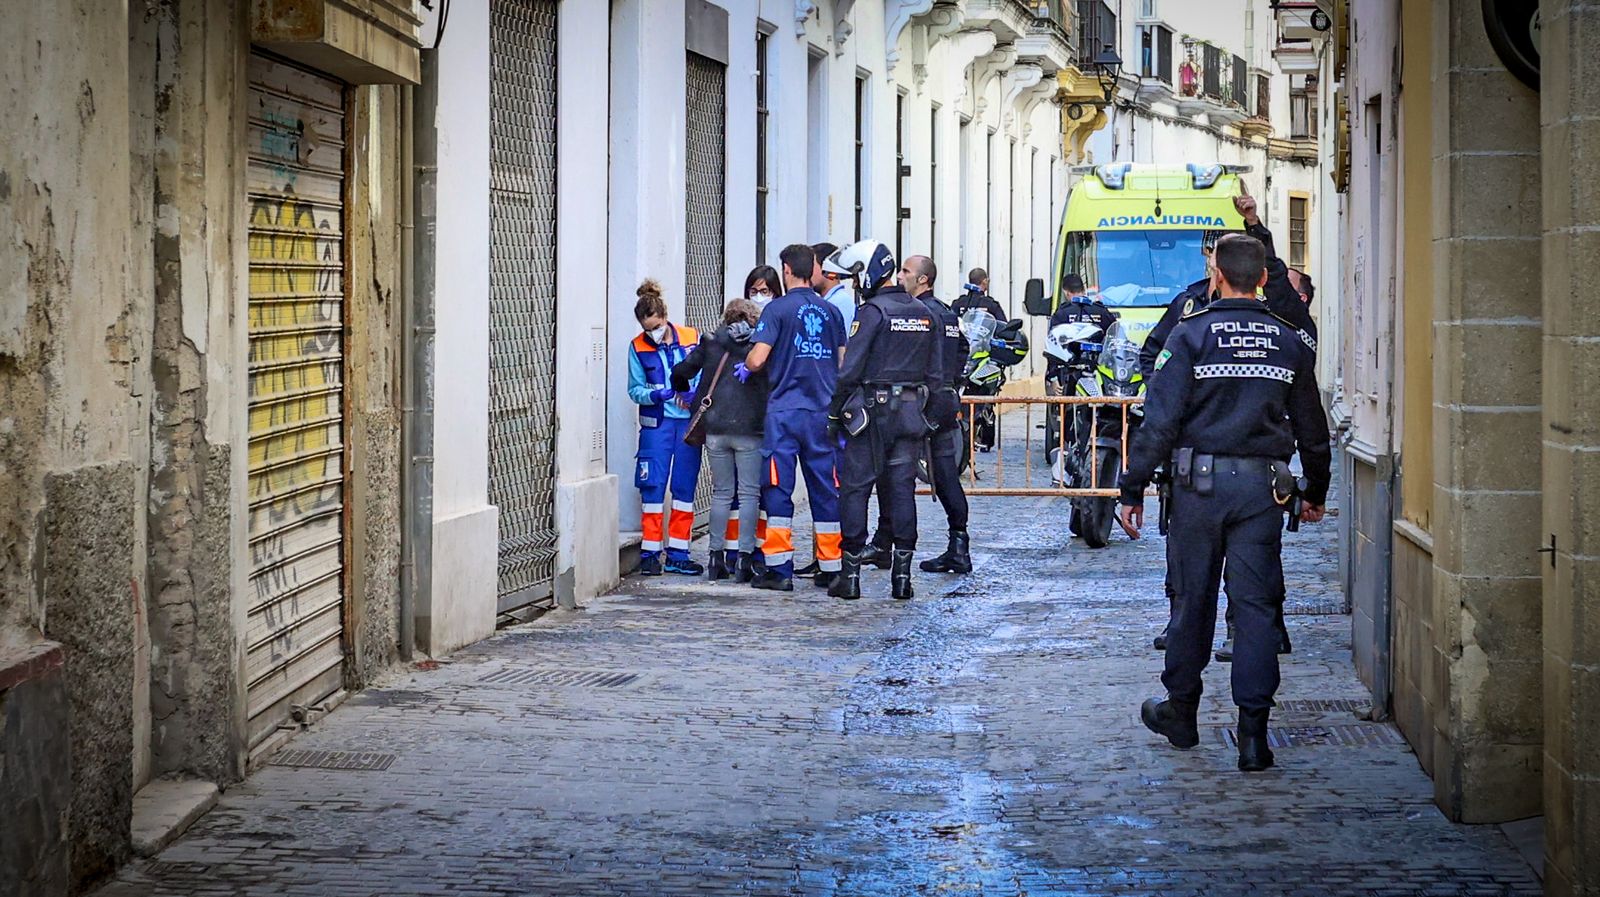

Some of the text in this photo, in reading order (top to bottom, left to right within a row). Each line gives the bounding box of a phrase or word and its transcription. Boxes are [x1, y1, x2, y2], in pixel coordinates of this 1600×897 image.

[1210, 321, 1280, 336] POLICIA
[1217, 336, 1280, 350] LOCAL
[1233, 350, 1268, 358] JEREZ
